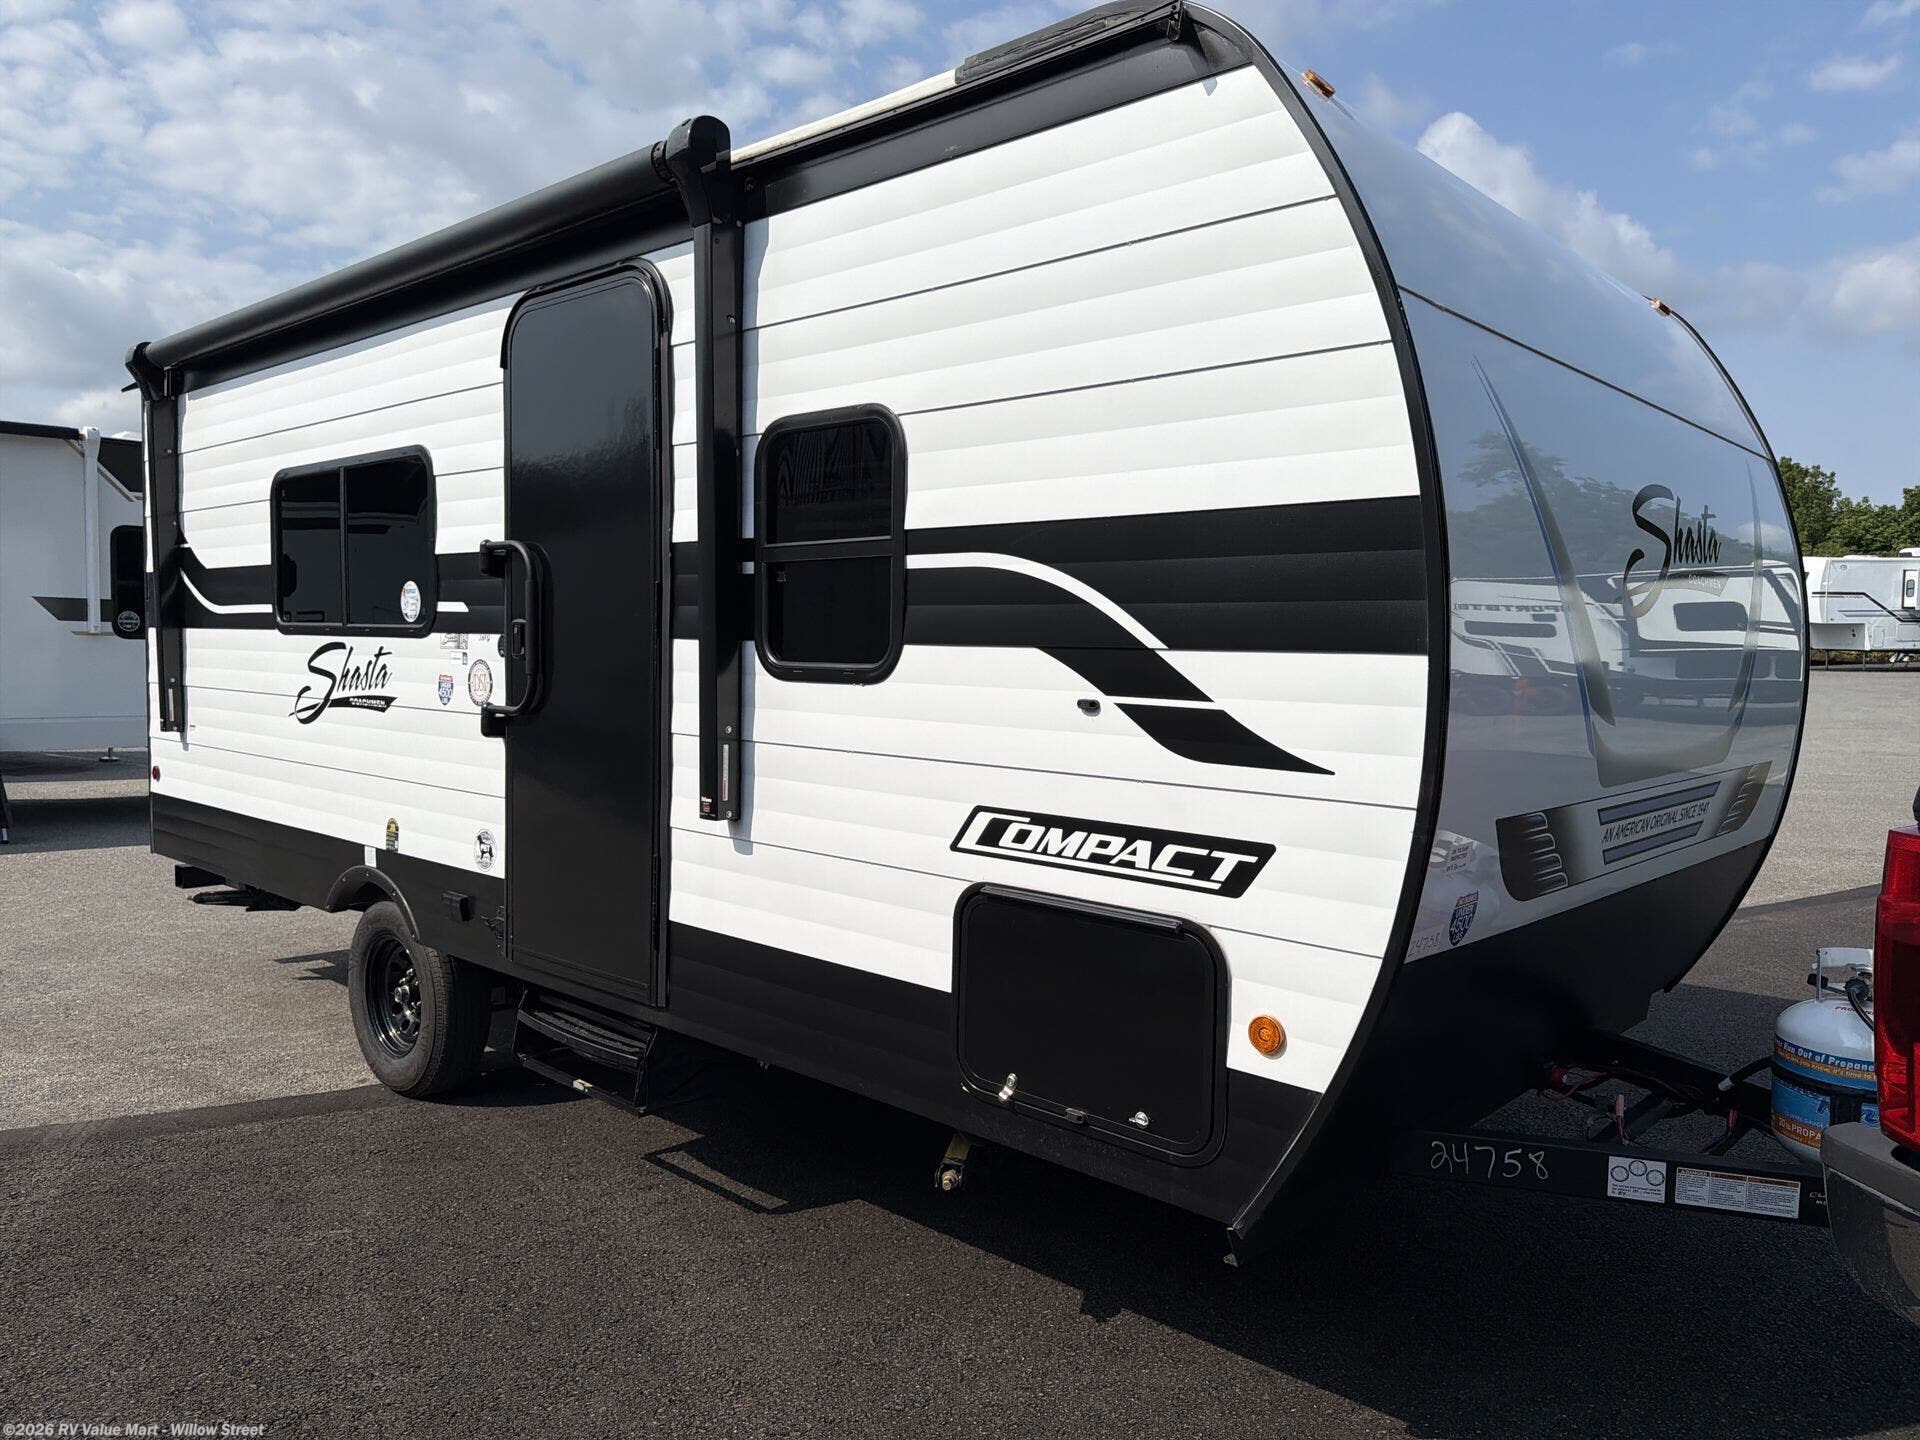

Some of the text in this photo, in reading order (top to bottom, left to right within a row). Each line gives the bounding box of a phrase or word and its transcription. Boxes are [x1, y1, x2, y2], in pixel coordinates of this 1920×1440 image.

[1622, 484, 1721, 618] Shasta
[295, 641, 393, 725] Shasta
[1602, 826, 1615, 844] AN
[1614, 818, 1650, 840] AMERICAN
[1650, 809, 1679, 830] ORIGINAL
[1679, 804, 1698, 821] SINCE
[957, 811, 1259, 888] COMPACT
[1450, 914, 1473, 934] 4500
[1455, 905, 1474, 918] UNDER
[1783, 1042, 1796, 1054] Run
[1797, 1048, 1812, 1060] Out
[1814, 1054, 1826, 1063] of
[1828, 1056, 1875, 1072] Propane
[1430, 1141, 1549, 1179] 24758
